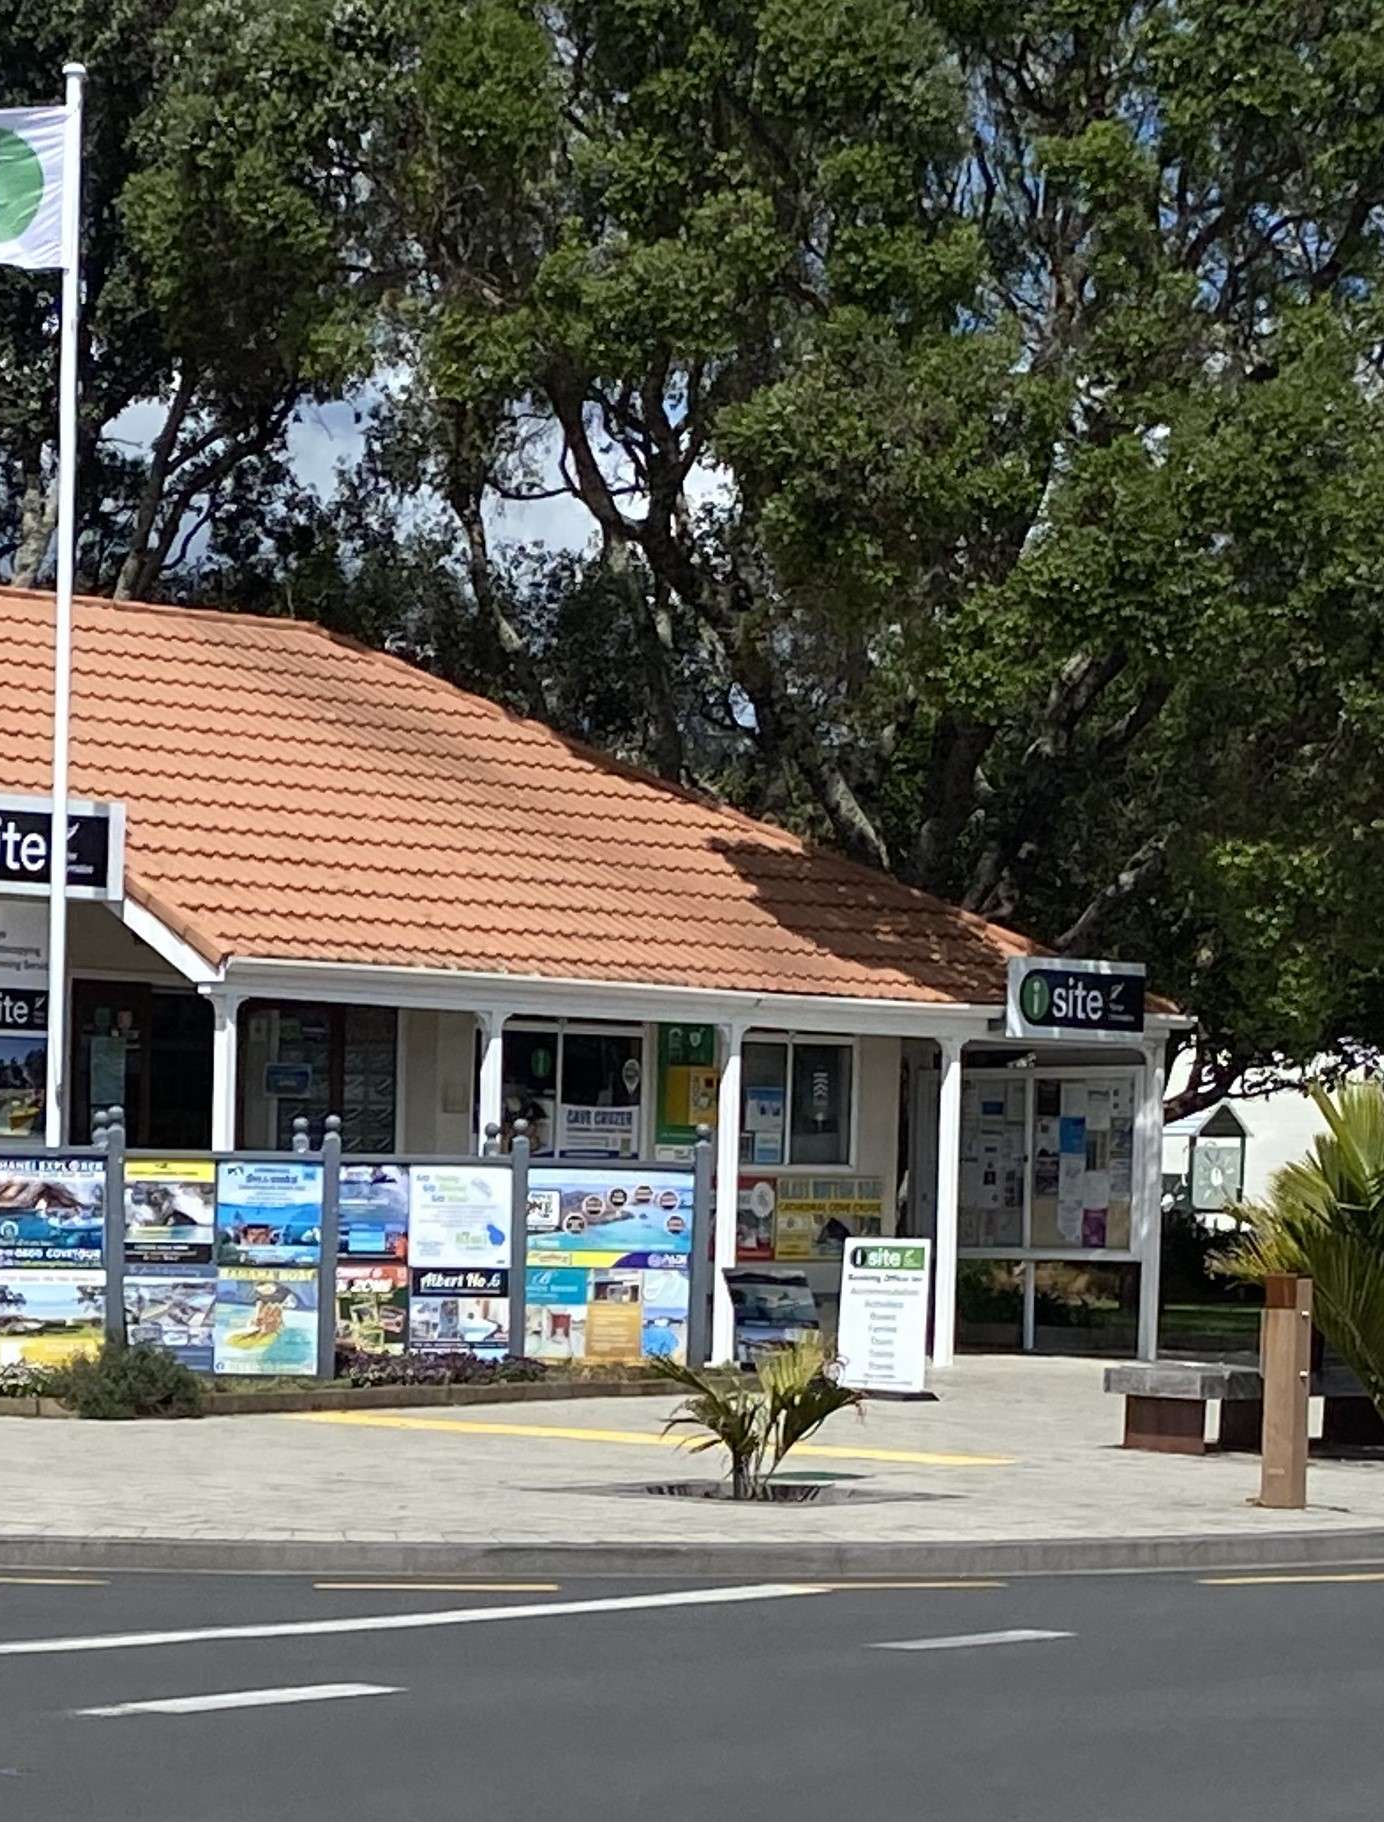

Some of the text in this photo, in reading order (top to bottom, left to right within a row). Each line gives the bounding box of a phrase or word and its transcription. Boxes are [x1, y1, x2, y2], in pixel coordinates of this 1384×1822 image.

[1052, 977, 1103, 1020] site
[867, 1248, 901, 1269] site
[420, 1272, 464, 1290] Albert
